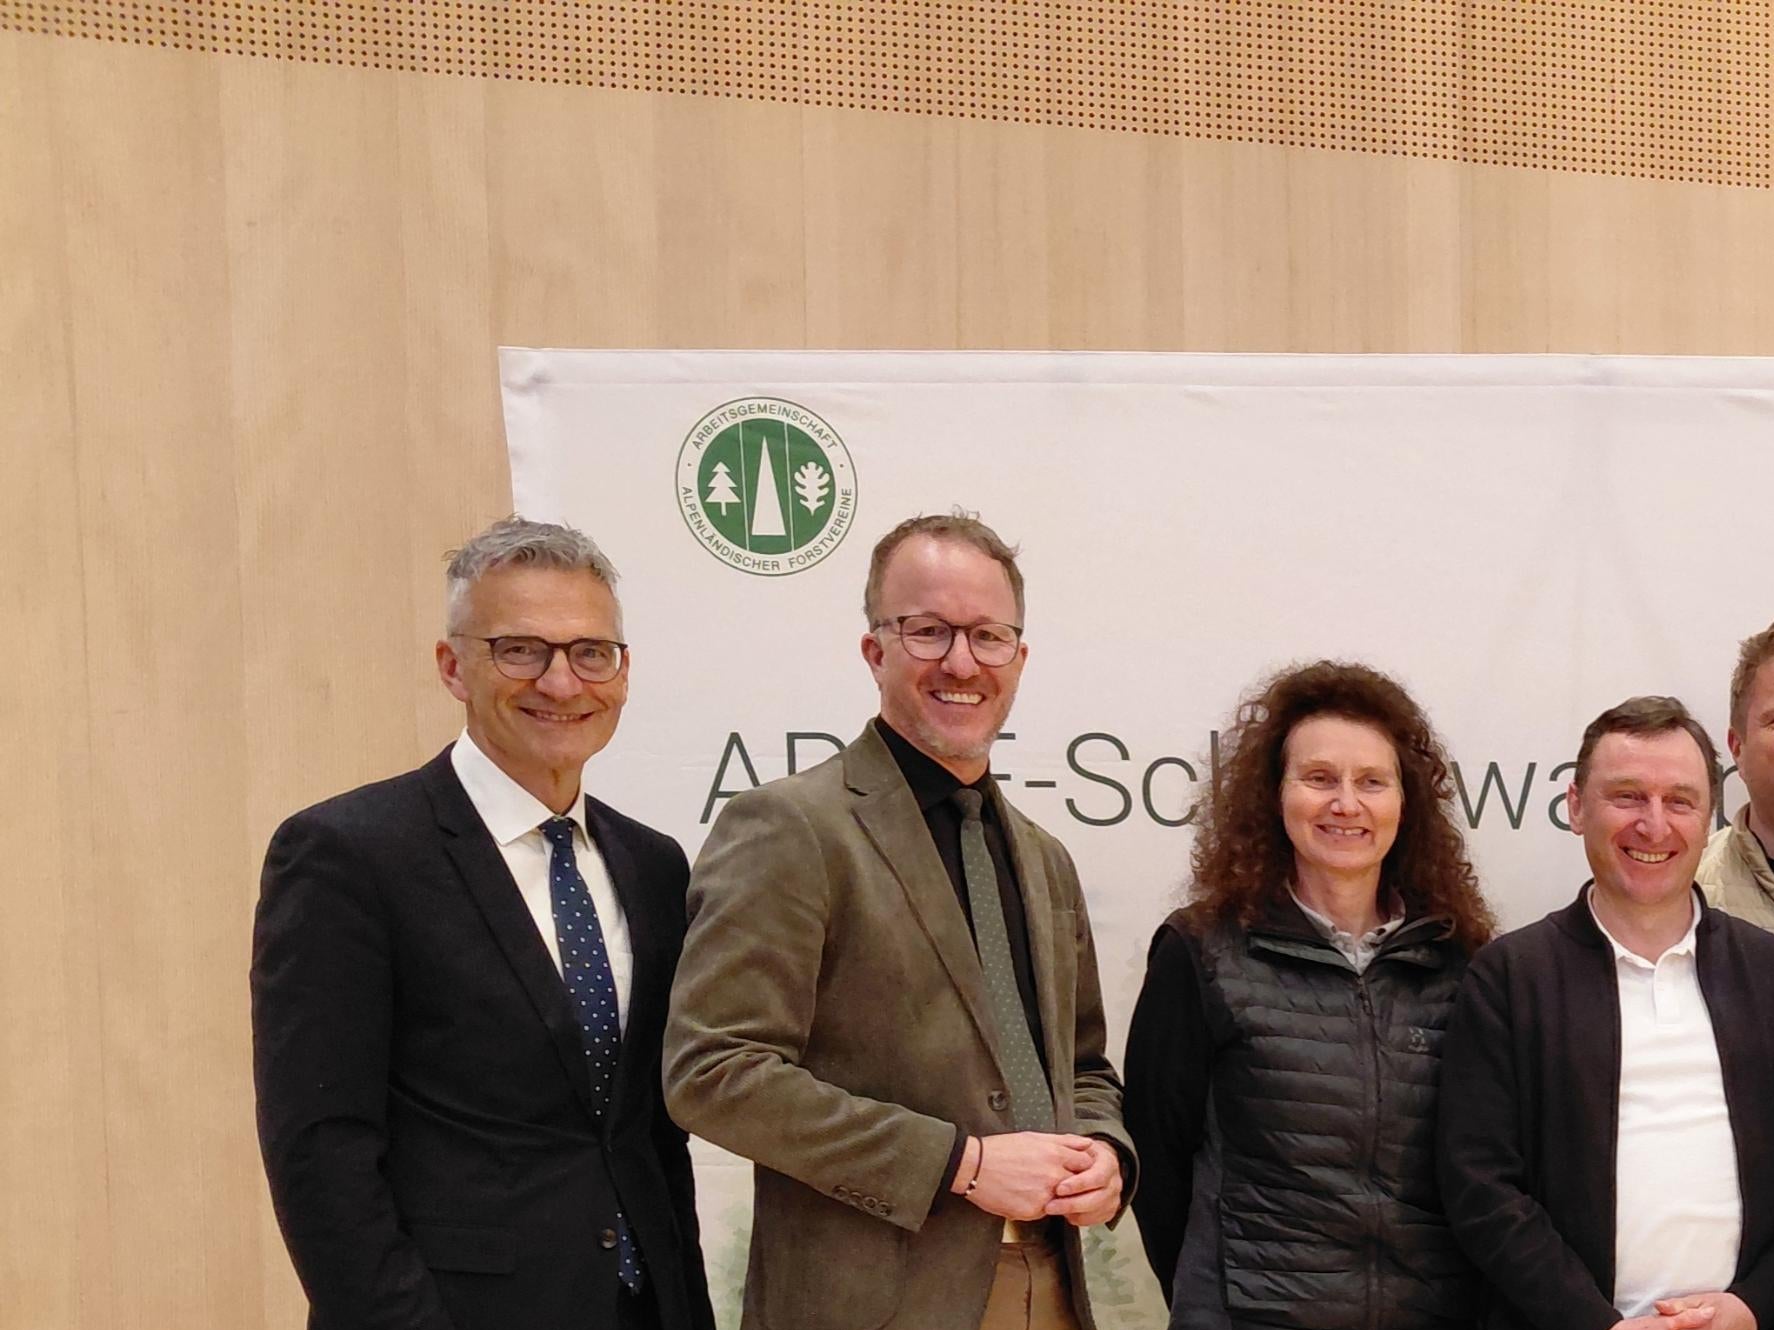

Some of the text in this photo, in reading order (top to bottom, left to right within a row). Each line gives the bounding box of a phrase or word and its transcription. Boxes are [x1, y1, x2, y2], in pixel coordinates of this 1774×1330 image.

[692, 403, 838, 450] ARBEITSGEMEINSCHAFT
[681, 486, 853, 571] ALPENLÄNDISCHER FORSTVEREINE
